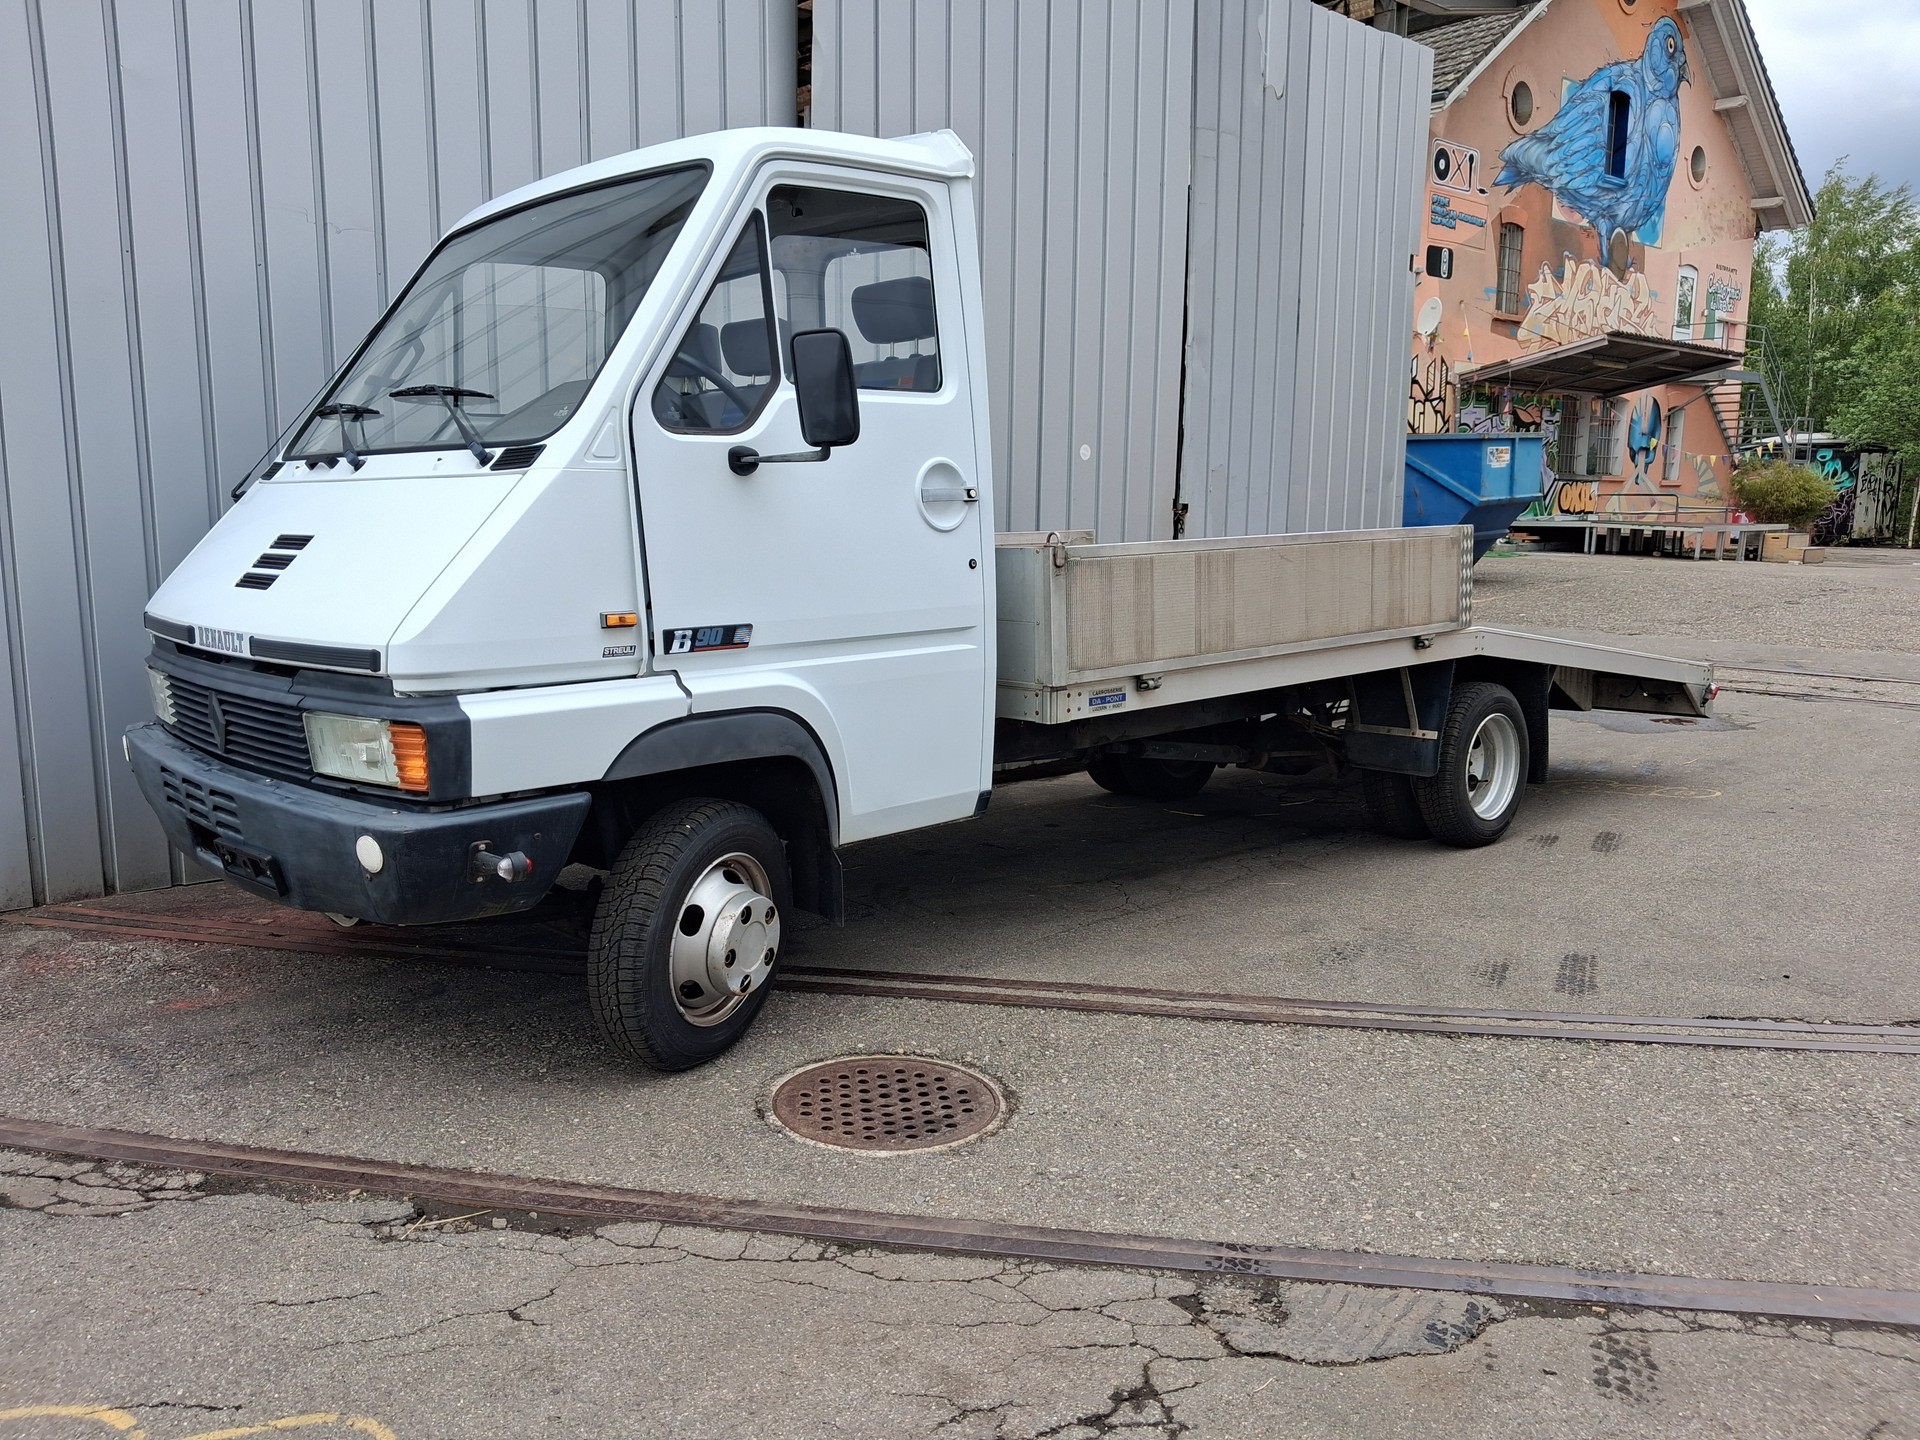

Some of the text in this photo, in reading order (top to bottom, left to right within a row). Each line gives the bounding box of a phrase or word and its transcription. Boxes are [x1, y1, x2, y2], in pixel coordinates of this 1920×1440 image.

[198, 626, 244, 654] RENAULT
[604, 645, 635, 655] STREULI
[1105, 694, 1123, 703] PONT
